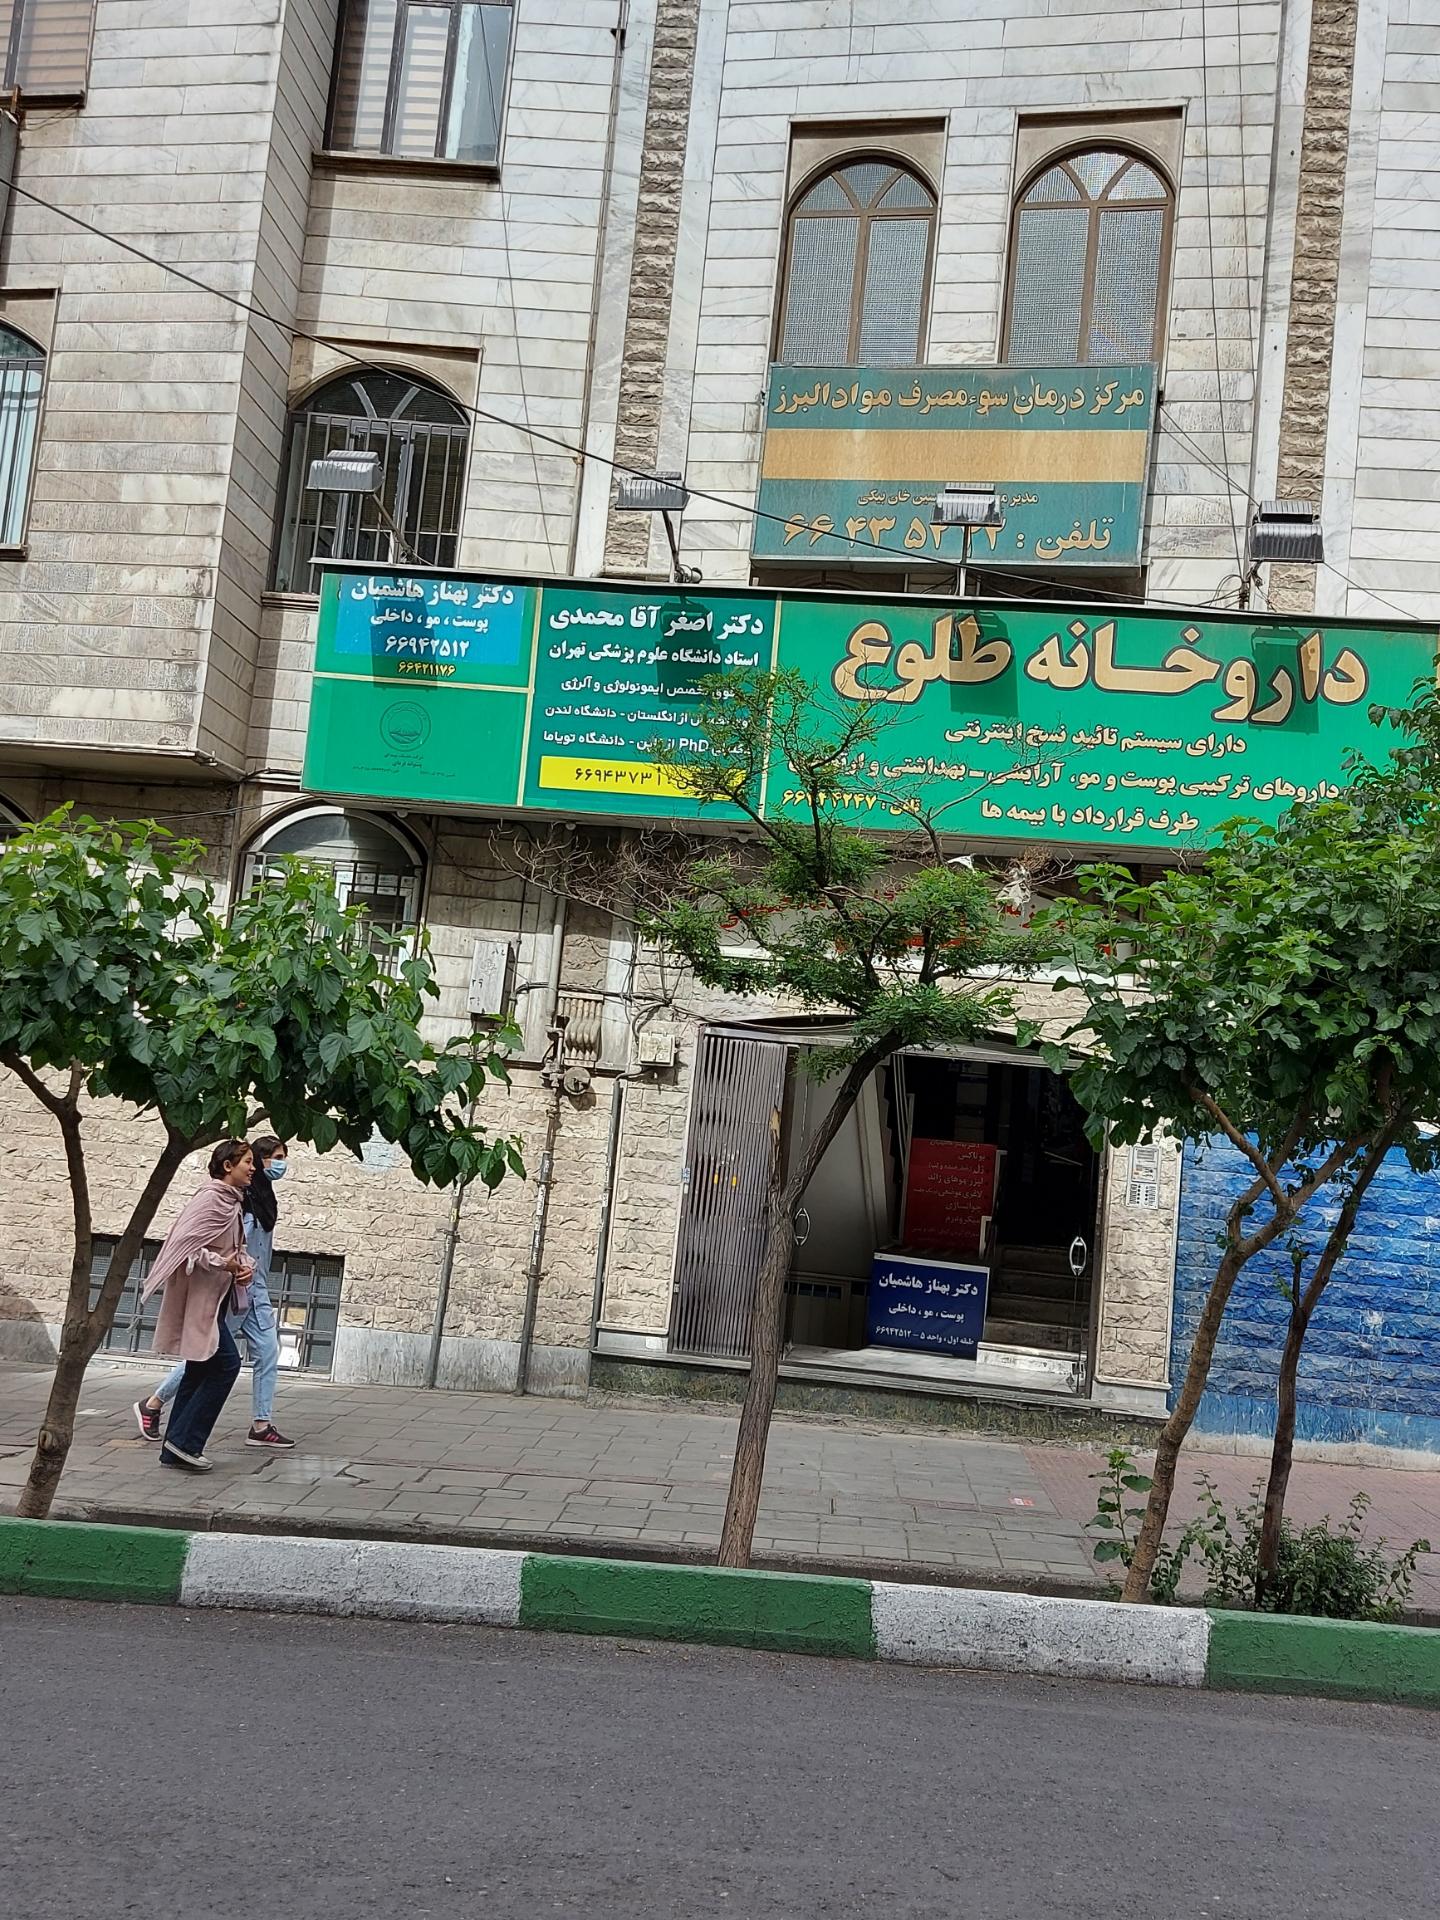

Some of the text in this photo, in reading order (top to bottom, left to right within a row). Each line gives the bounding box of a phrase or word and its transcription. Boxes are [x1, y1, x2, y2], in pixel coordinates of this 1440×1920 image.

[1013, 383, 1085, 414] درمان
[1088, 381, 1145, 414] مرکز
[888, 489, 911, 506] خان
[912, 494, 938, 506] سین
[1009, 492, 1039, 507] مدیر
[1035, 517, 1114, 560] تلفن
[351, 576, 514, 608] دکتر بهناز هاشمیان
[370, 608, 414, 625] داخلی
[452, 616, 489, 634] پوست
[550, 605, 764, 640] دکتر اصغر آقا محمدی
[384, 635, 470, 658] ۶۶۹۴۲۵۱۲
[549, 640, 760, 667] استاد دانشگاه علوم پزشکی تهران
[398, 661, 456, 677] ۶۶۴۲۱۱۷۶
[831, 611, 1368, 726] داروخانه طلوع
[561, 675, 593, 691] آلرژی
[593, 681, 600, 692] و
[603, 679, 664, 695] ایمونولوژی
[544, 705, 572, 717] لندن
[574, 705, 617, 718] دانشگاه
[627, 710, 677, 722] انگلستان
[677, 713, 688, 725] از
[543, 730, 576, 744] تویاما
[579, 733, 625, 746] دانشگاه
[944, 720, 1023, 745] اینترنتی
[1026, 724, 1067, 748] نسخ
[679, 737, 710, 753] PhD
[1120, 732, 1183, 752] سیستم
[1186, 732, 1247, 757] دارای
[883, 756, 967, 781] بهداشتی
[1103, 774, 1118, 791] و
[1120, 772, 1176, 797] پوست
[1179, 774, 1250, 799] ترکیبی
[1252, 776, 1340, 803] داروهای
[981, 799, 1199, 835] طرف قرارداد با بیمه ها
[879, 1273, 978, 1296] دکتر بهناز هاشمیان
[888, 1302, 917, 1315] داخلی
[940, 1311, 964, 1323] پوست
[926, 1334, 942, 1343] واحد
